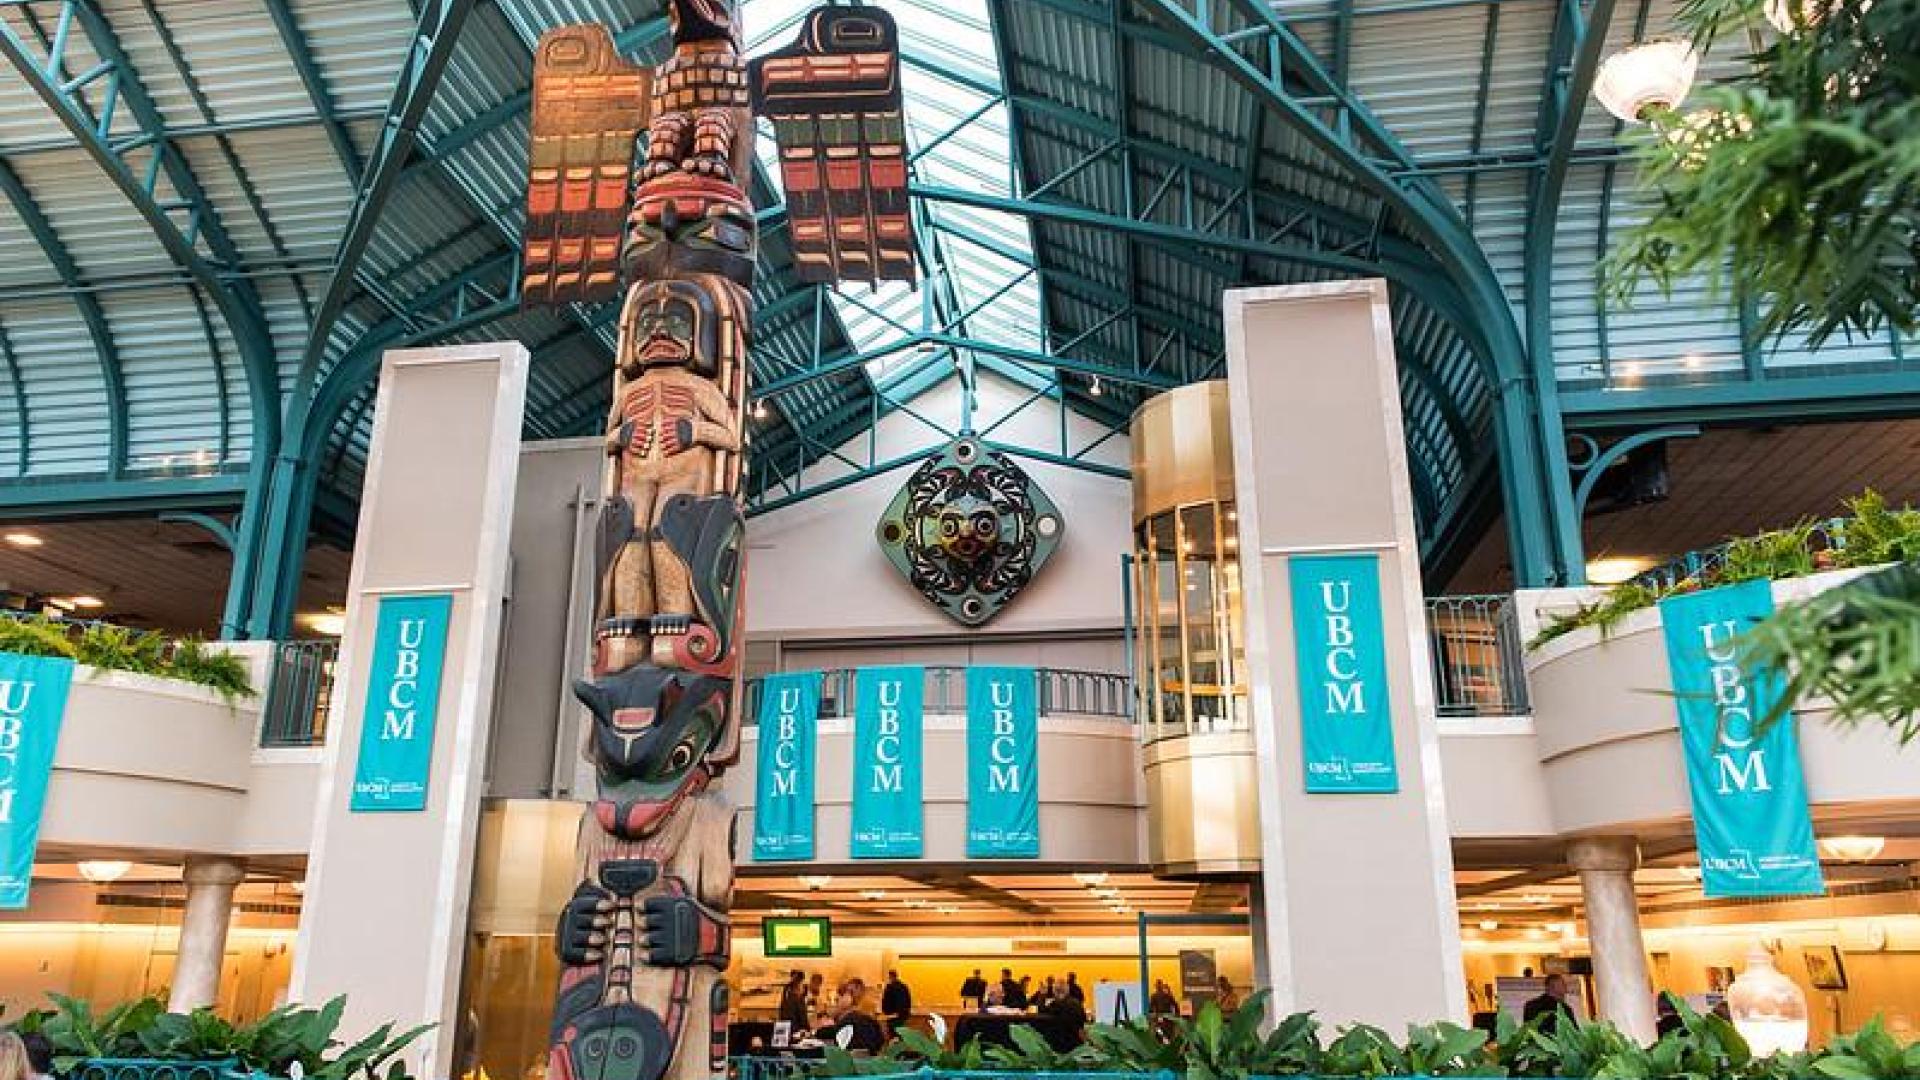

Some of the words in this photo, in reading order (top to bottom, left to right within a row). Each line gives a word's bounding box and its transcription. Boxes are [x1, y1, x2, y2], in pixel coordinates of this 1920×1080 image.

[381, 618, 424, 740] UBCM
[1320, 581, 1366, 714] UBCM
[771, 687, 801, 797] UBCM
[871, 680, 903, 793] UBCM
[987, 681, 1020, 793] UBCM
[1699, 620, 1771, 795] UBCM
